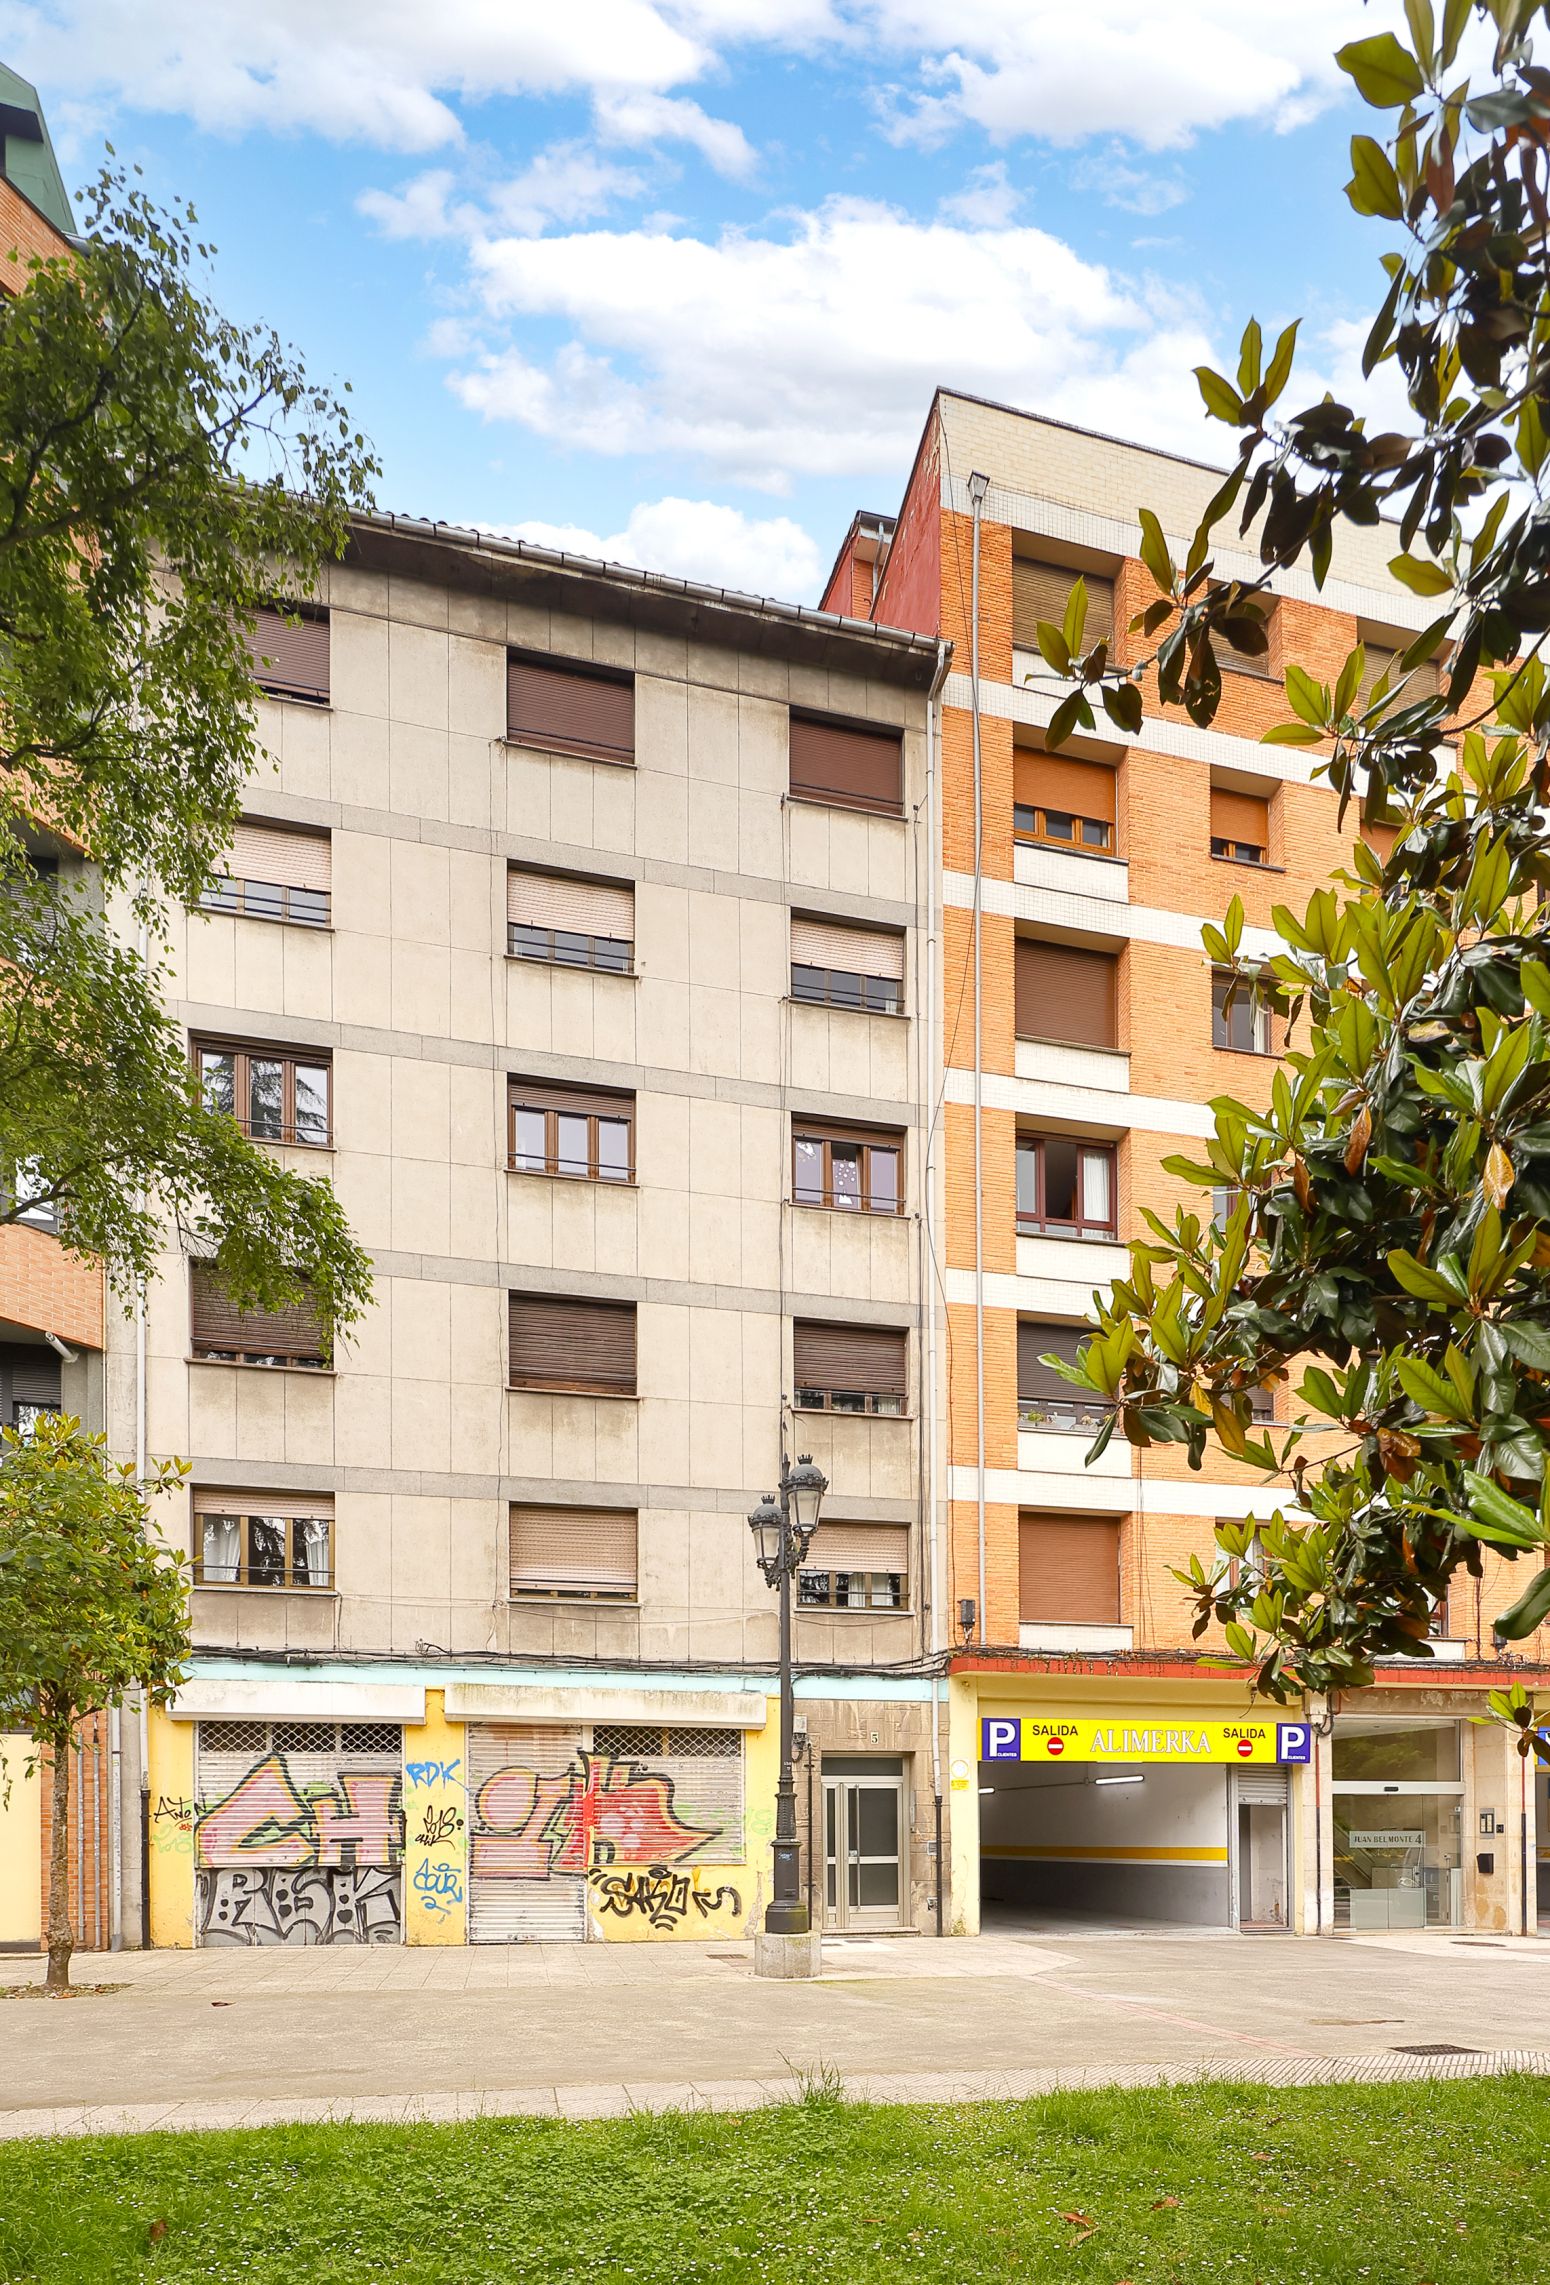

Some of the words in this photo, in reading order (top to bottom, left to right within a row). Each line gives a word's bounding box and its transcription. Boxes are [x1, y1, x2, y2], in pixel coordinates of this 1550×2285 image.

[1032, 1725, 1079, 1736] SALIDA
[1223, 1728, 1266, 1739] SALIDA
[871, 1733, 878, 1744] 5
[989, 1721, 1016, 1757] P
[1090, 1729, 1212, 1754] ALIMERKA
[1280, 1726, 1305, 1760] P
[1354, 1835, 1372, 1843] JUAN
[1373, 1835, 1413, 1843] BELMONTE
[1415, 1833, 1422, 1845] 4
